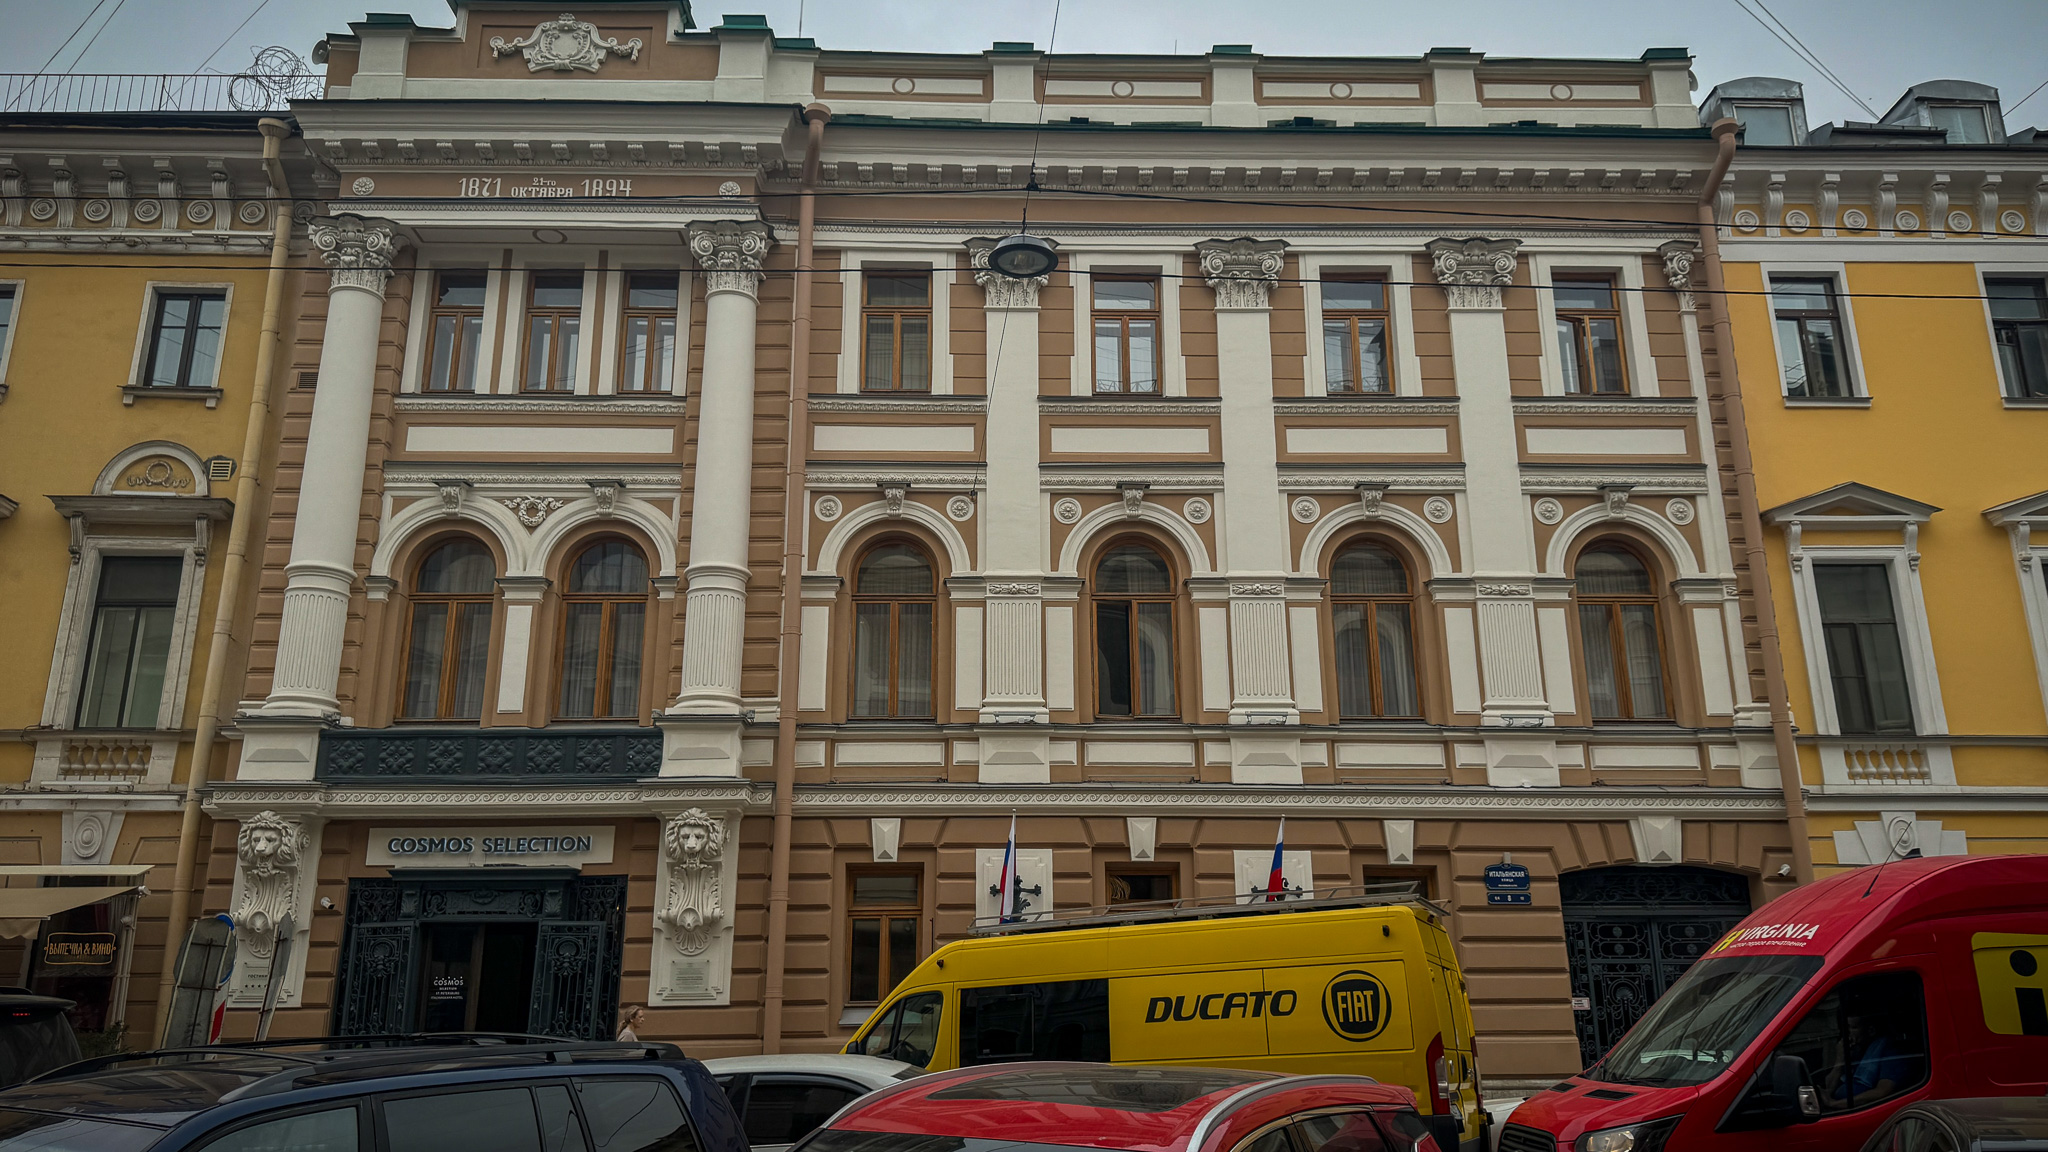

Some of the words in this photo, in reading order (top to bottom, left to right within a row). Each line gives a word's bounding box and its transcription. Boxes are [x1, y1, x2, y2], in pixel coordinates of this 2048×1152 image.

[458, 177, 502, 198] 1871
[510, 186, 574, 198] ОКТЯБРЯ
[580, 178, 632, 198] 1894
[387, 836, 474, 854] COSMOS
[482, 835, 592, 854] SELECTION
[1737, 923, 1820, 941] VIRGINIA
[91, 942, 112, 955] ВИНО
[1145, 990, 1298, 1024] DUCATO
[1336, 990, 1374, 1023] FIAT
